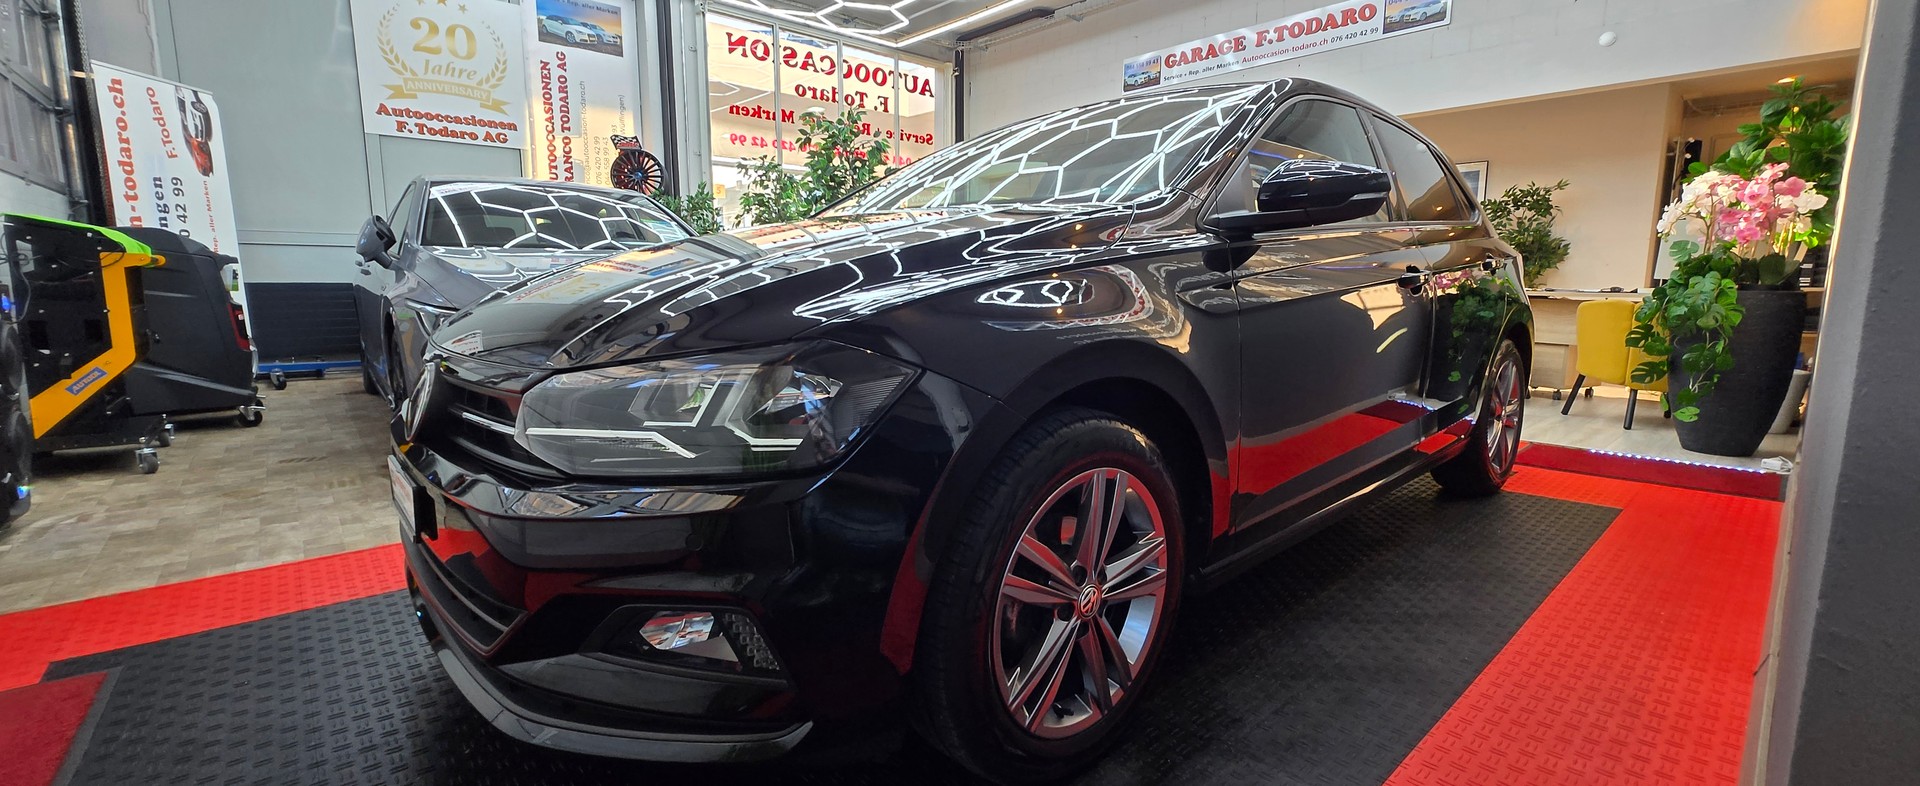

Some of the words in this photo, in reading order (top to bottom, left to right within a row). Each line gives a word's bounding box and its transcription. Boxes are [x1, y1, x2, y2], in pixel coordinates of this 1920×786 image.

[409, 16, 478, 61] 20
[1164, 36, 1247, 69] GARAGE
[1202, 65, 1216, 73] aller
[1216, 60, 1240, 70] Marken
[1241, 37, 1329, 64] Autooccasion-todaro.ch
[1330, 34, 1344, 44] 076
[1344, 31, 1358, 41] 420
[1359, 28, 1369, 38] 42
[1370, 26, 1380, 35] 99
[422, 59, 478, 80] Jahre
[556, 51, 567, 72] AG
[406, 80, 489, 100] ANNIVERSARY
[557, 74, 571, 133] TODARO
[375, 102, 518, 131] Autooccasionen
[414, 122, 479, 141] Todaro
[482, 131, 509, 144] AG
[593, 135, 601, 145] 99
[593, 145, 601, 156] 42
[594, 156, 602, 170] 420
[171, 176, 184, 197] 99
[595, 172, 603, 185] 076
[203, 180, 212, 212] Marken
[175, 203, 188, 224] 42
[208, 214, 216, 232] aller
